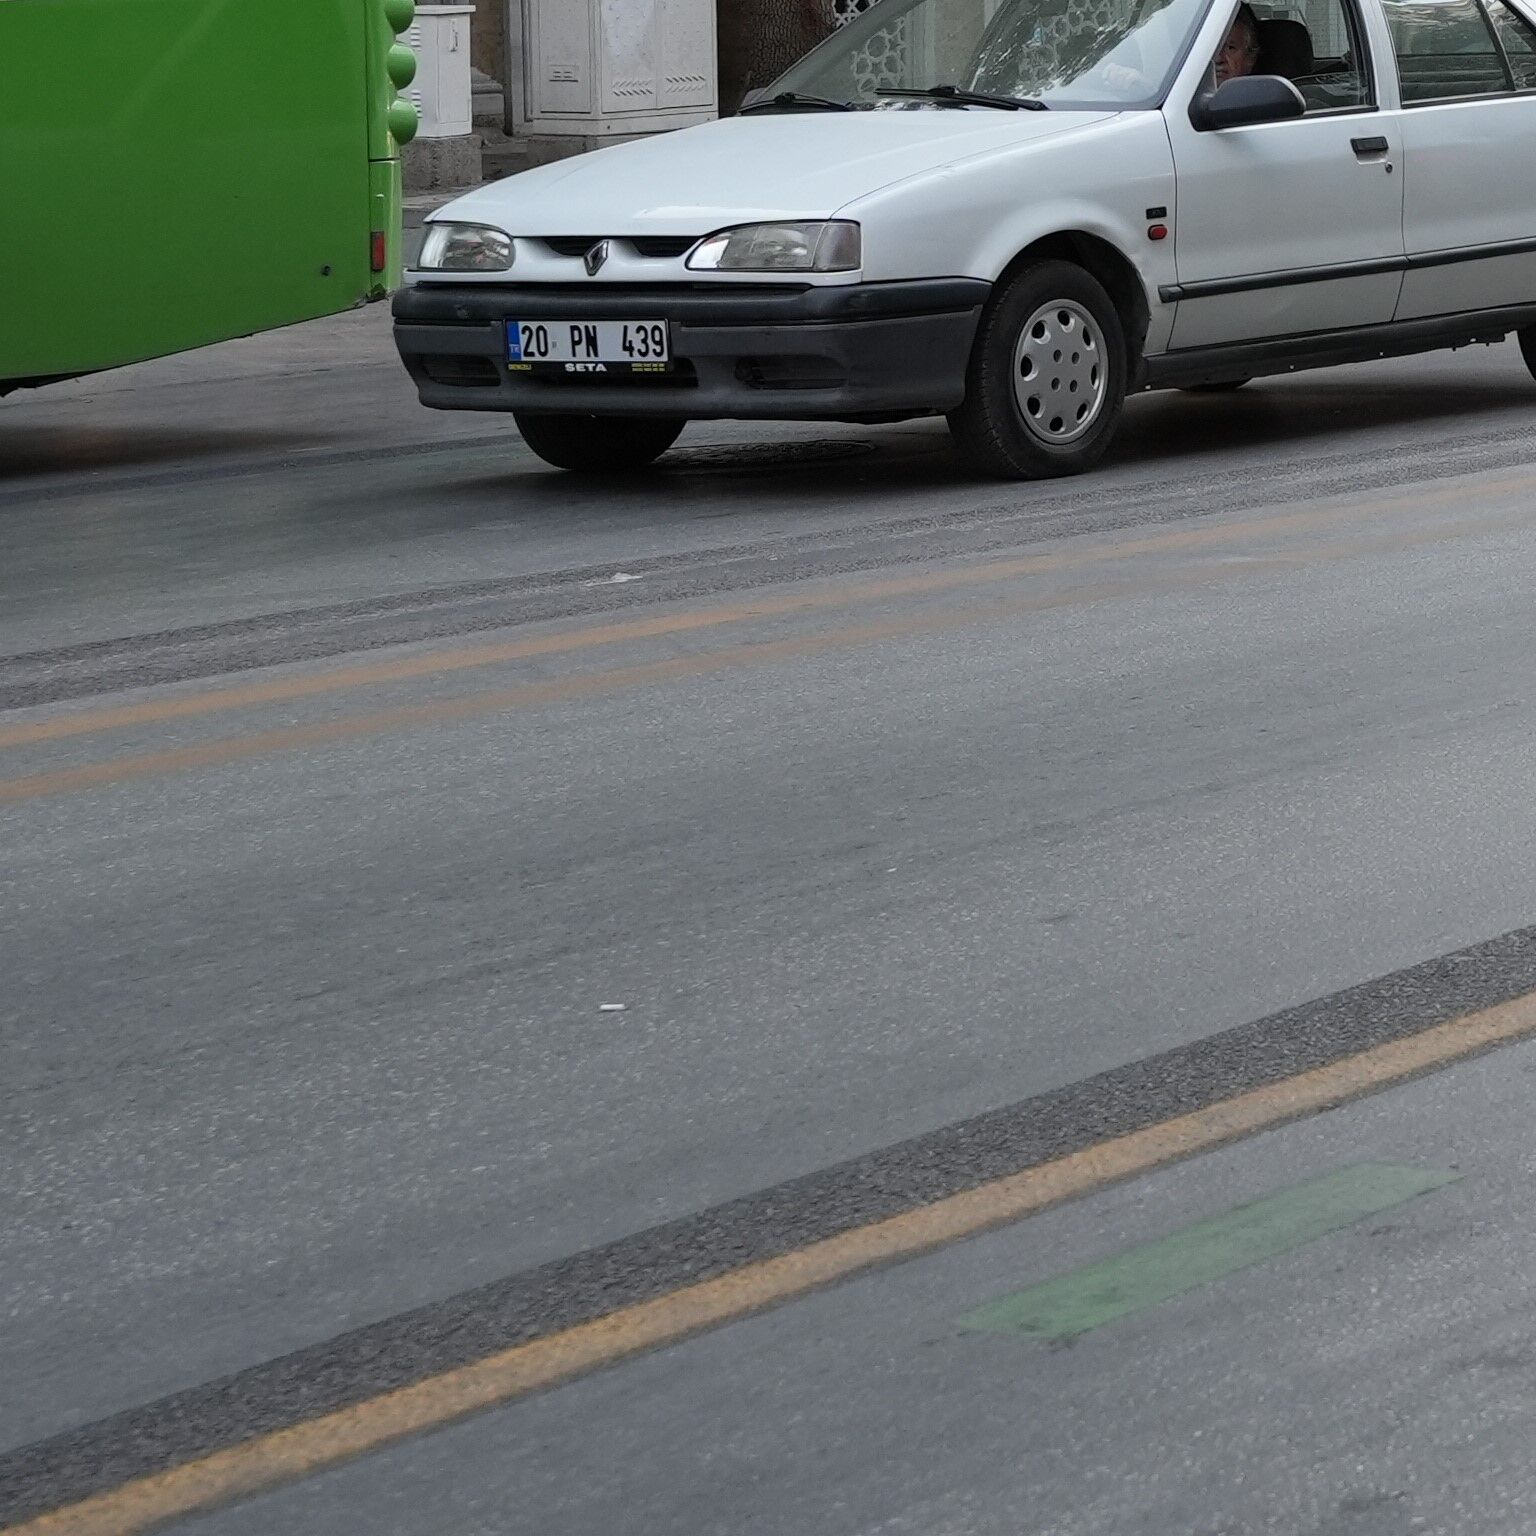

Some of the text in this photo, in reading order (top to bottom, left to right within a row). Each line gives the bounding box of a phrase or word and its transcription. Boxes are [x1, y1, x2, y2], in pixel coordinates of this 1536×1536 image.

[521, 325, 549, 357] 20
[569, 325, 599, 358] PN
[622, 325, 665, 358] 439
[564, 363, 608, 372] SETA
